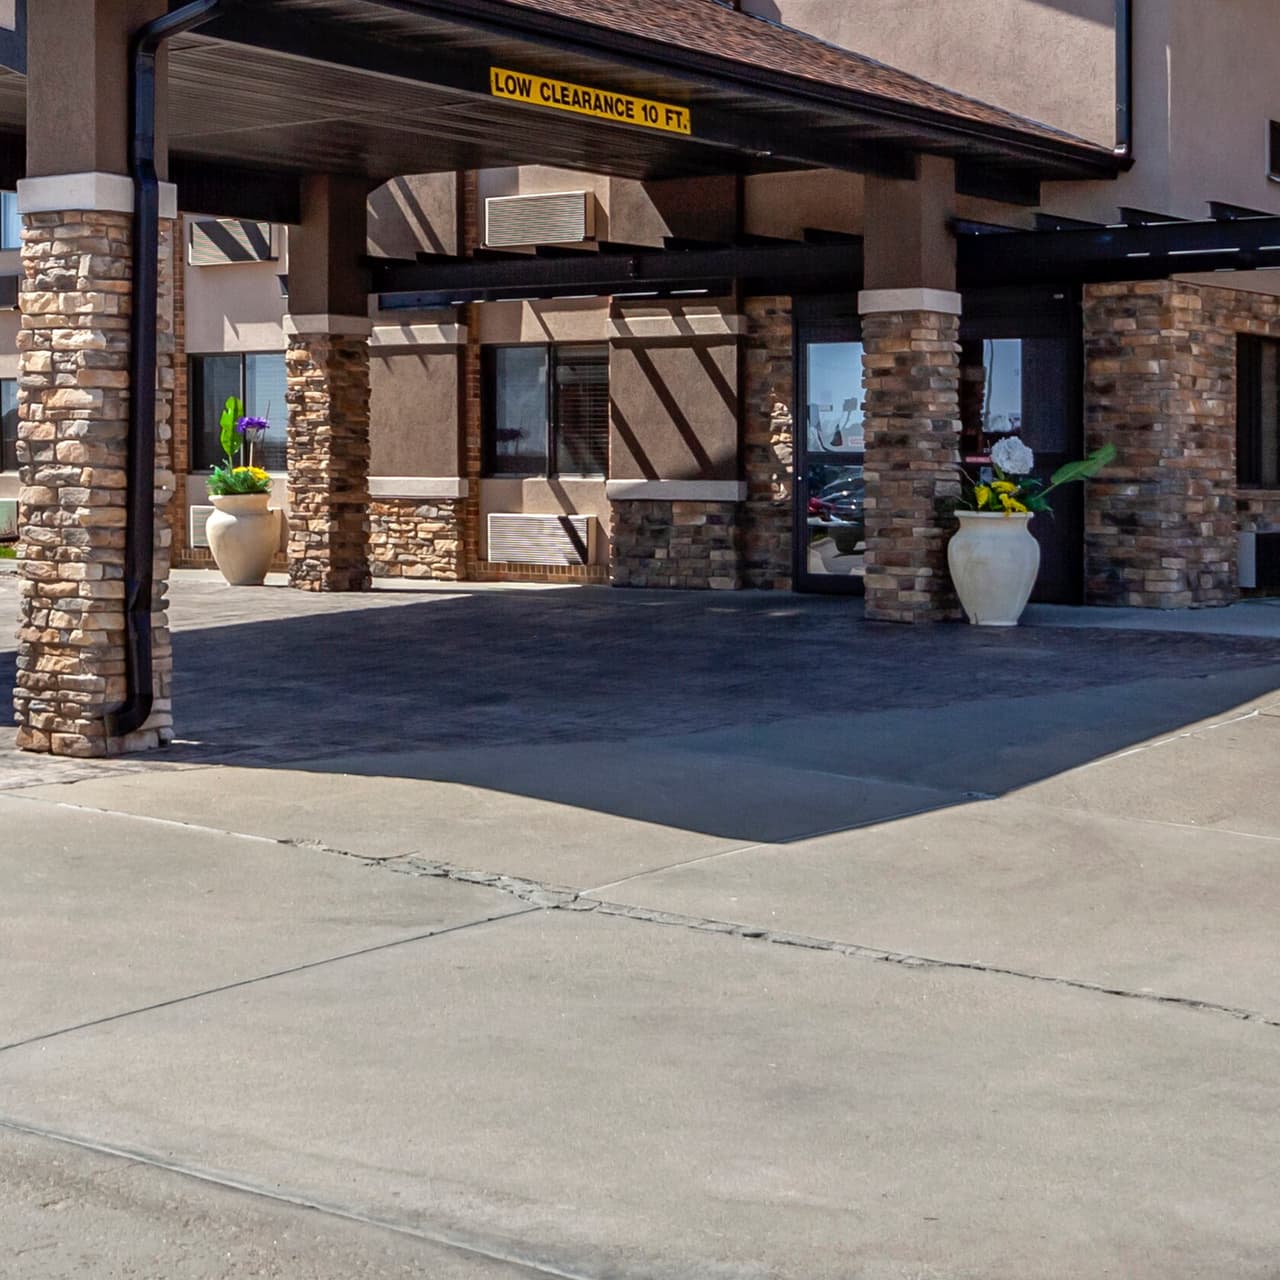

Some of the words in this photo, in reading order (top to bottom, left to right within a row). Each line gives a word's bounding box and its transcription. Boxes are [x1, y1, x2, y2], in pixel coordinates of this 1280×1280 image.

[494, 72, 532, 98] LOW
[539, 82, 635, 119] CLEARANCE
[641, 103, 659, 124] 10
[665, 108, 688, 130] FT.
